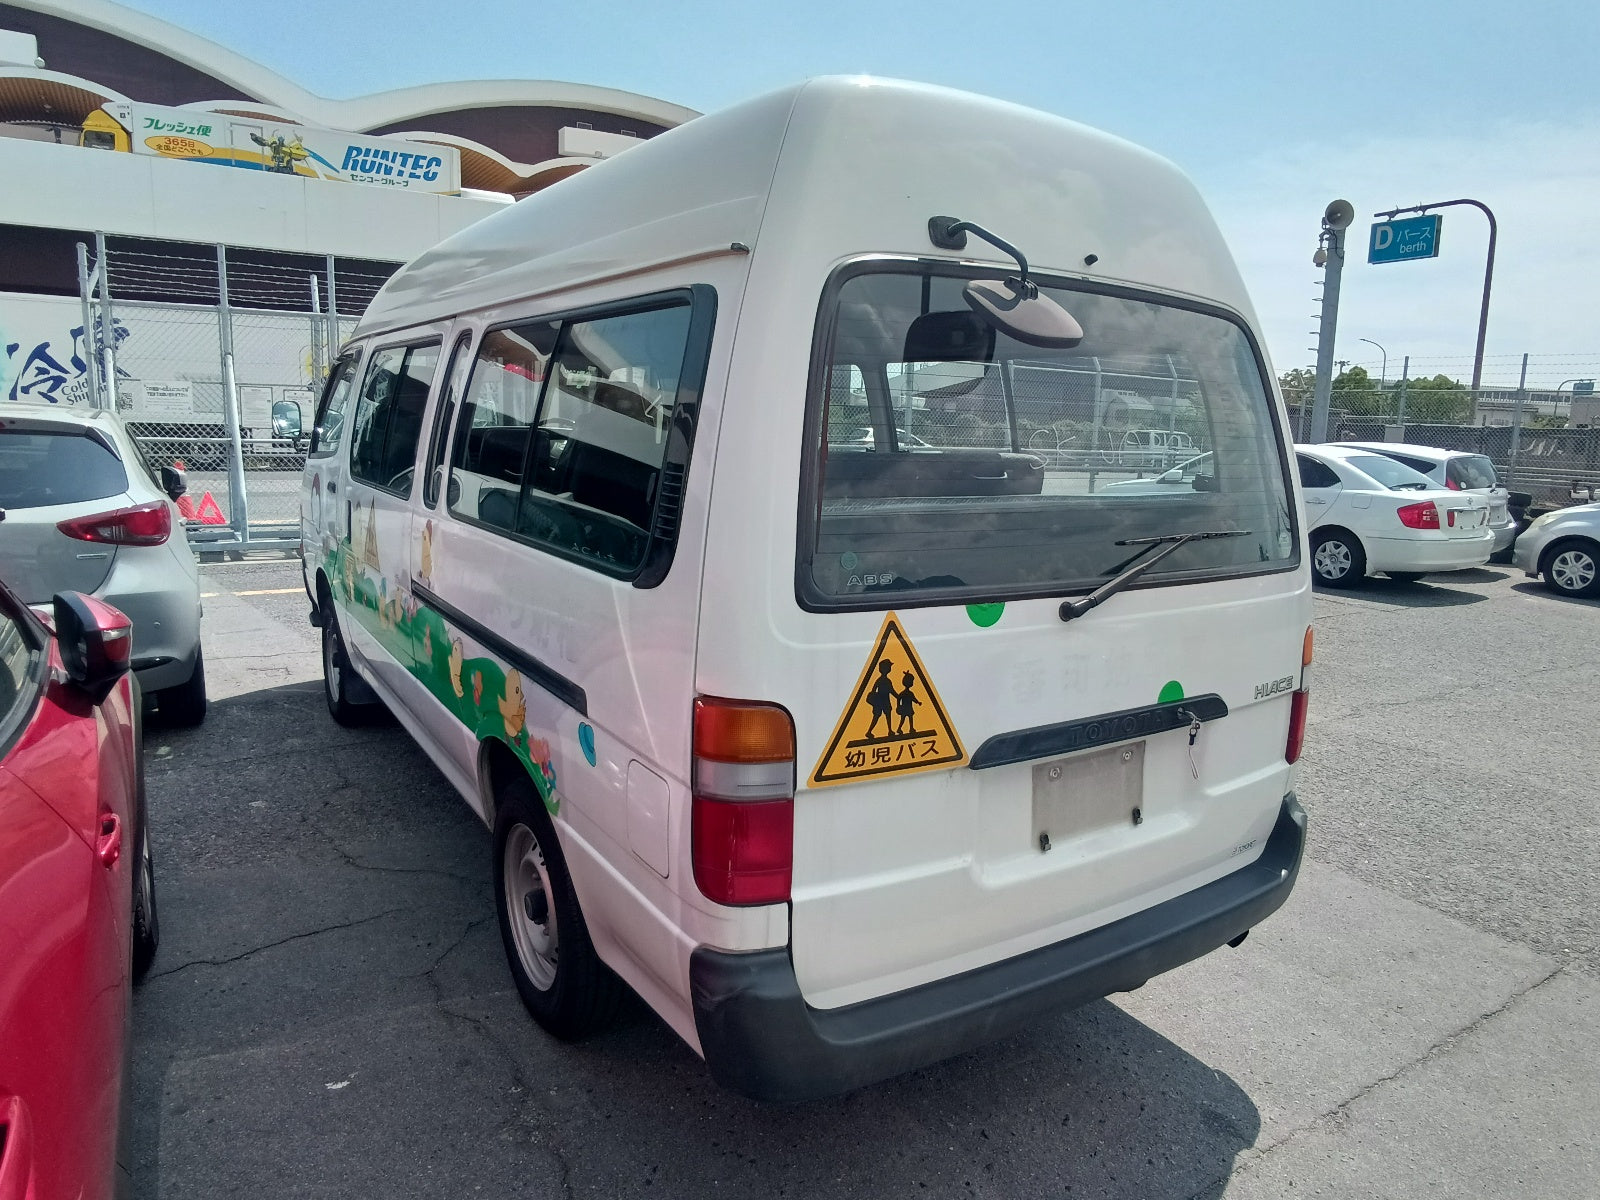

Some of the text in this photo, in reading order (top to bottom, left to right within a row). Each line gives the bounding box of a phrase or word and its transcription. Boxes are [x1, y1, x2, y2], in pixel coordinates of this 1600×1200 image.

[143, 117, 213, 137] フレッシュ便
[156, 143, 204, 156] 全国どこへでも
[164, 137, 195, 149] 365日
[341, 145, 442, 182] RUNTEC
[349, 173, 409, 187] センコーグループ
[1374, 225, 1431, 250] D バース
[1400, 240, 1427, 254] berth
[61, 377, 89, 396] Cold
[846, 573, 893, 586] ABS
[1253, 675, 1294, 700] HIACE
[1069, 709, 1168, 745] TOYOTA
[844, 739, 940, 768] 幼児バス
